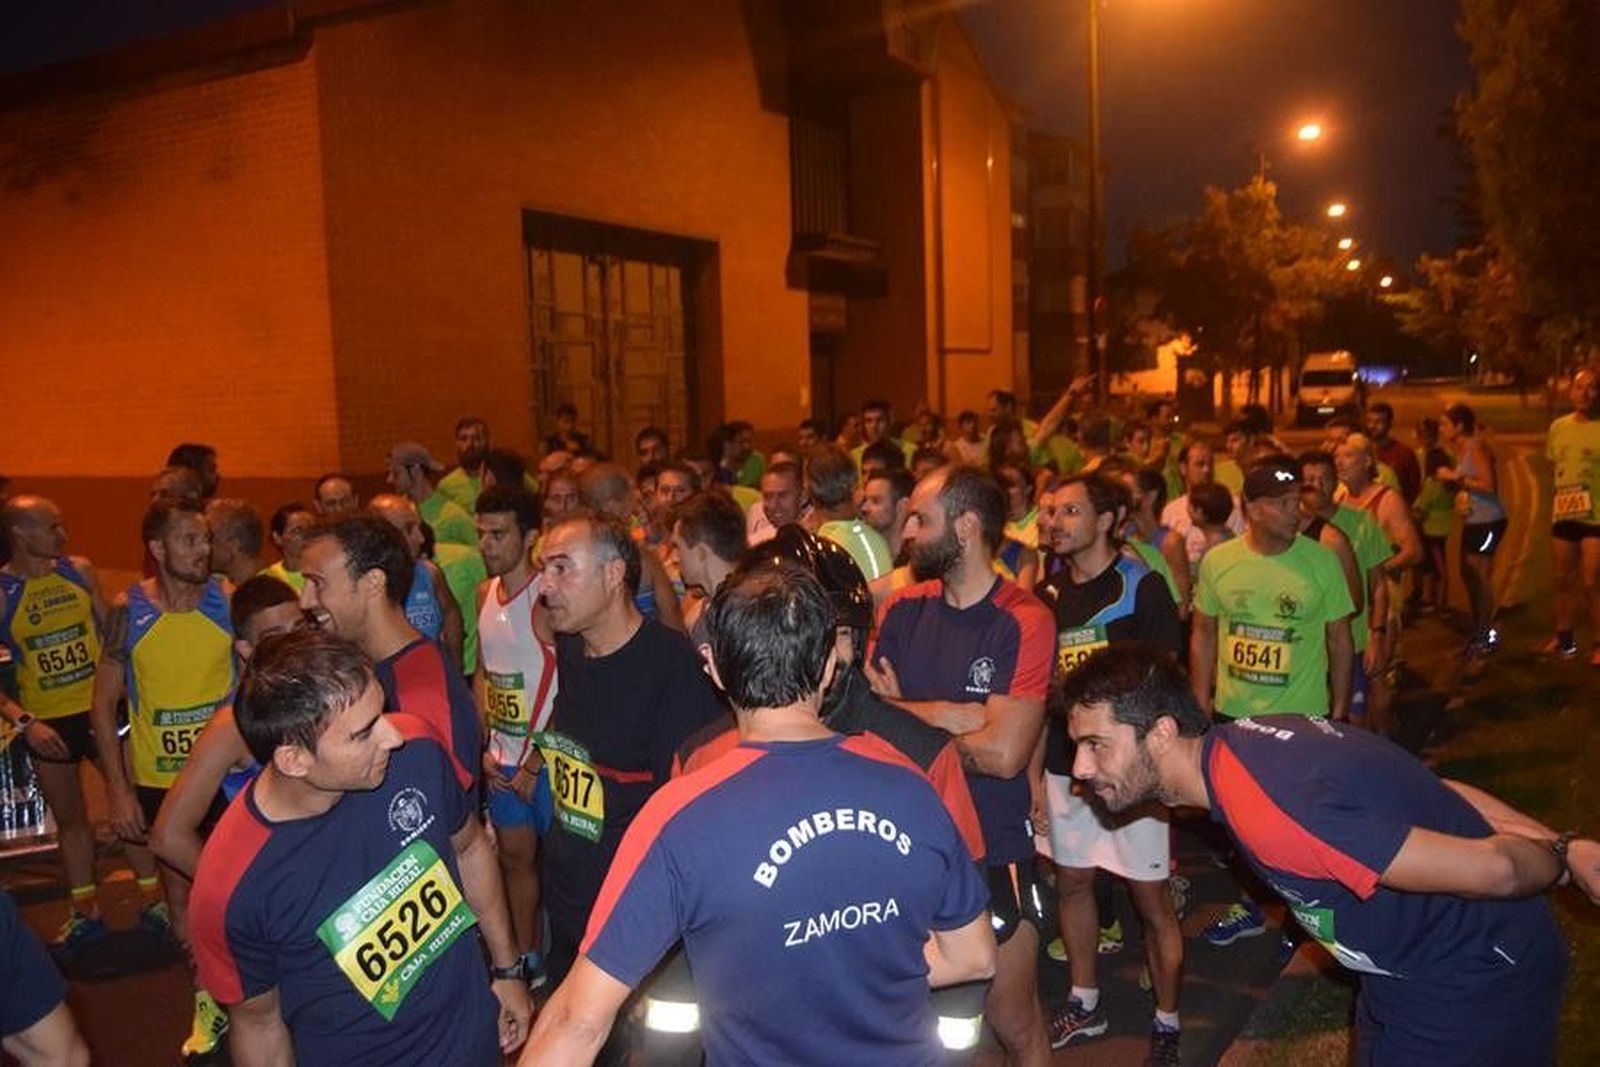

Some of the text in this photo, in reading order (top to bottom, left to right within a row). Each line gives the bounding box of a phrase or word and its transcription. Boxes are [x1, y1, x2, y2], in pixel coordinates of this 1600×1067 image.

[38, 641, 89, 674] 6543
[1233, 641, 1282, 670] 6541
[554, 756, 595, 809] 6517
[753, 808, 912, 888] BOMBEROS
[356, 879, 447, 982] 6526
[784, 898, 900, 947] ZAMORA
[400, 953, 428, 981] CAJA
